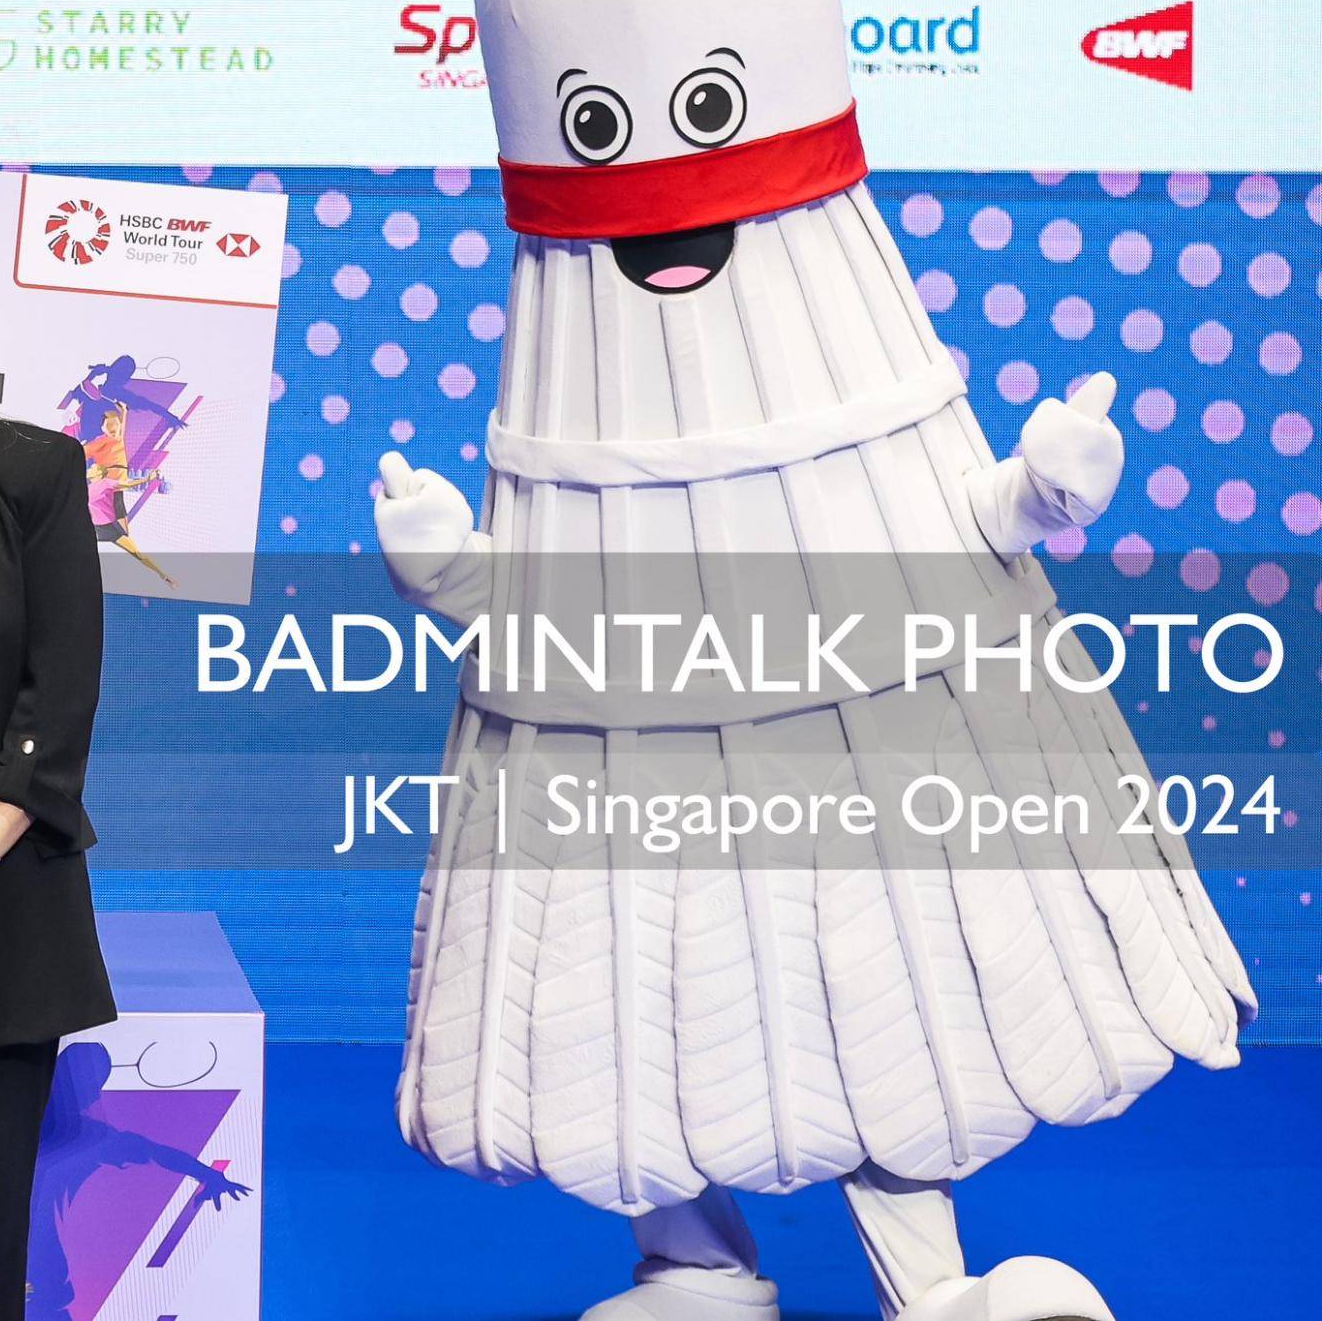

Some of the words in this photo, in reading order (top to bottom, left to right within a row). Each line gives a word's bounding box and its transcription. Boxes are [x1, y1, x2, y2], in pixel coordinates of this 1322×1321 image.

[37, 10, 190, 34] STARRY
[1092, 29, 1188, 60] BWF
[35, 46, 274, 71] HOMESTEAD
[119, 214, 163, 230] HSBC
[167, 218, 212, 233] BWF
[123, 231, 167, 247] World
[171, 235, 204, 250] Tour
[125, 247, 169, 264] Super
[172, 251, 198, 266] 750
